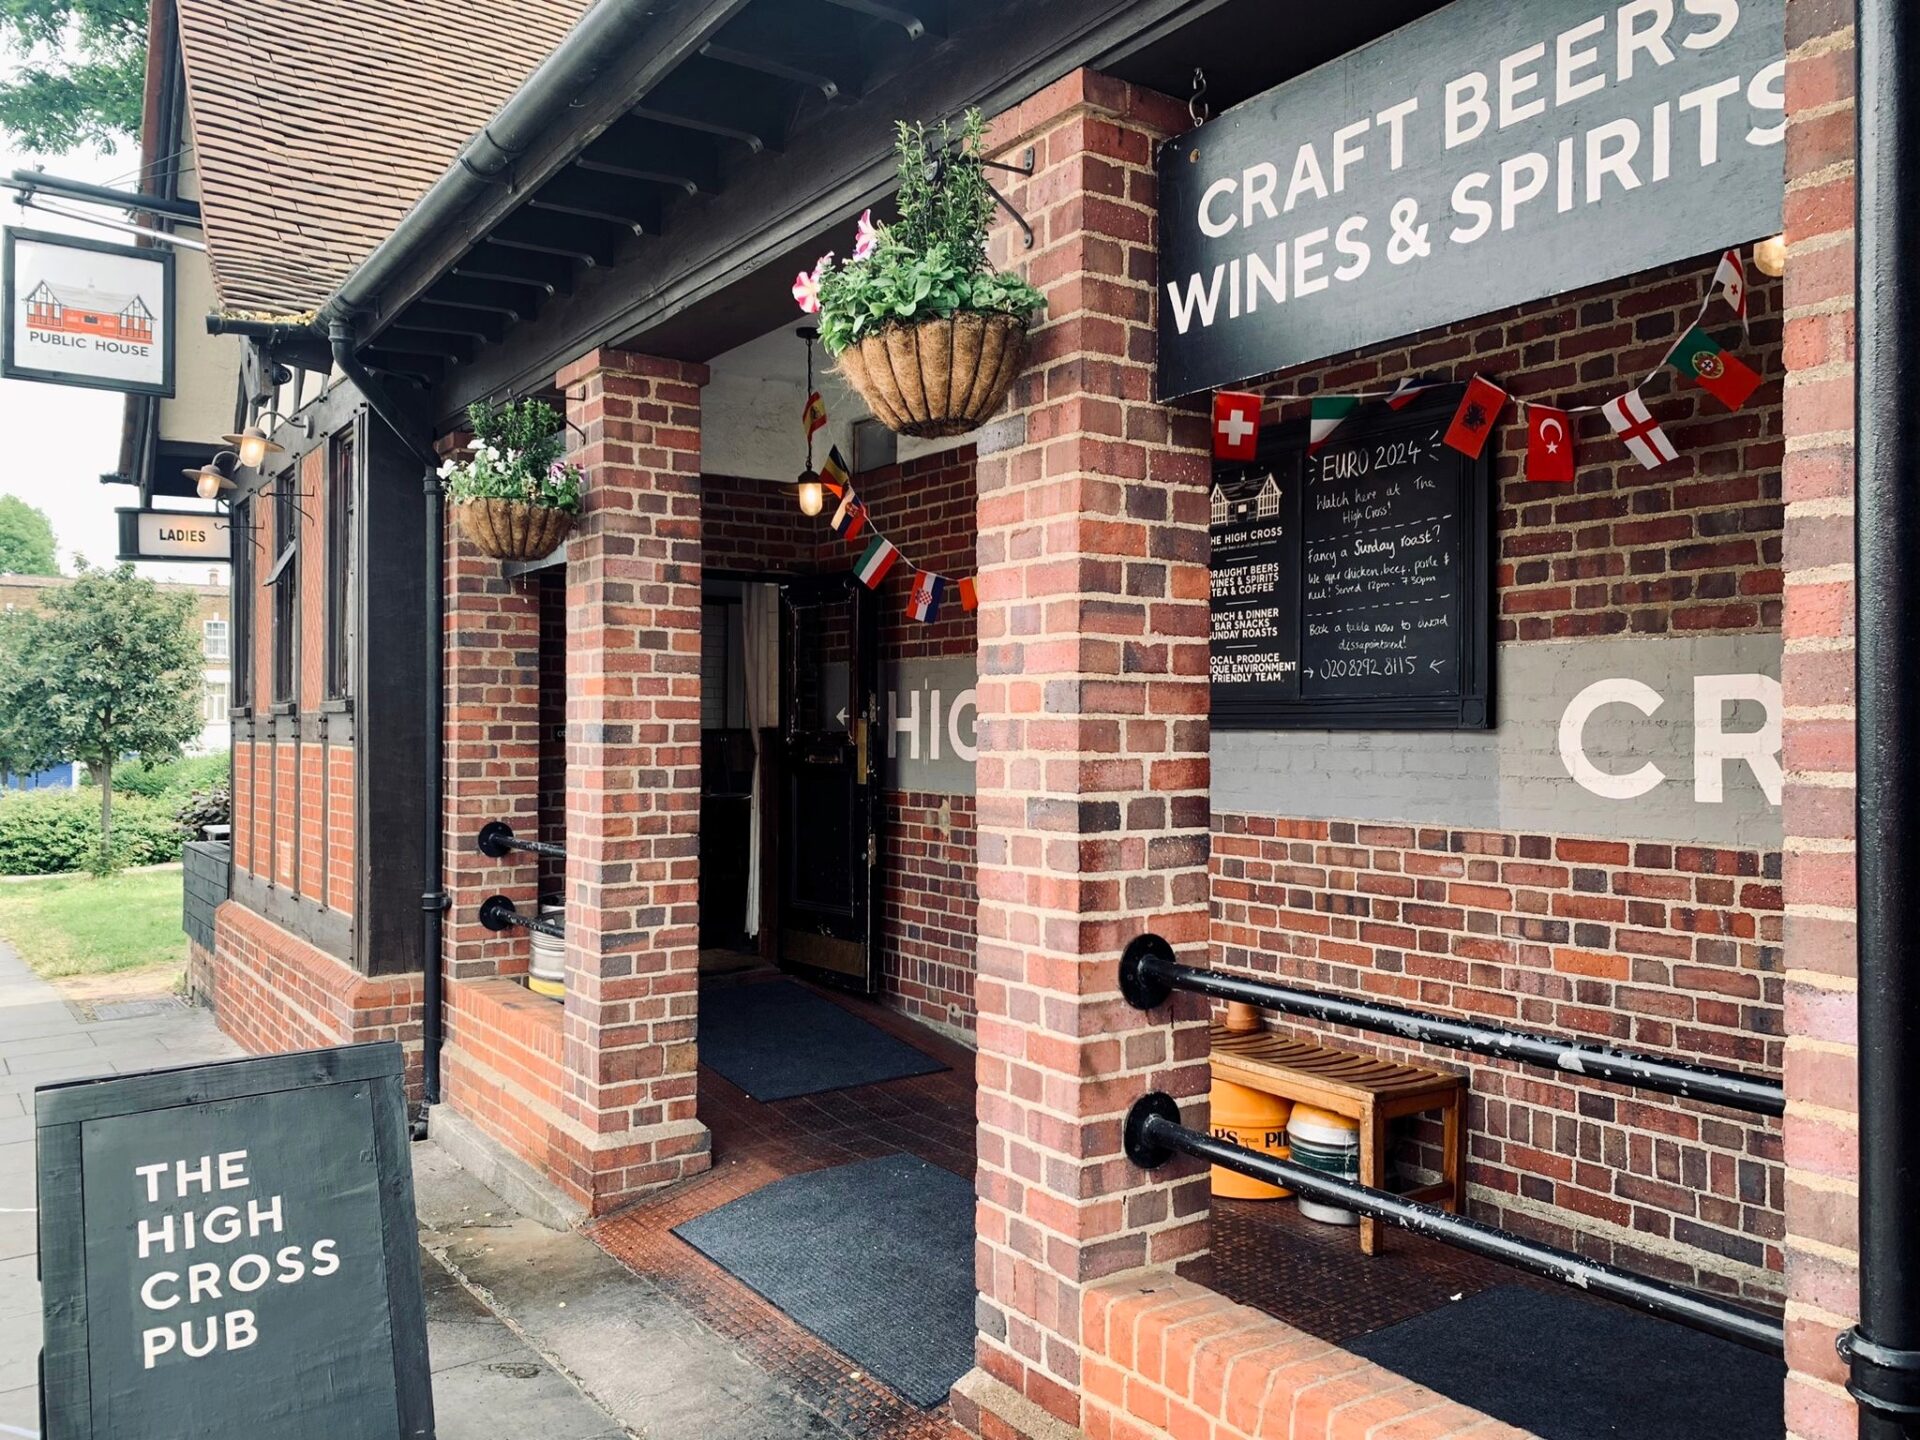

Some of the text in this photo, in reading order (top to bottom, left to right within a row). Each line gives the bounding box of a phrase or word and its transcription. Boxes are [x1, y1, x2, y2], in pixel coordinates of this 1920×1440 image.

[1197, 0, 1740, 238] CRAFT BEERS
[1167, 59, 1786, 335] WINES & SPIRITS
[29, 331, 149, 357] PUBLIC HOUSE
[1322, 440, 1422, 481] EURO 2024
[1316, 475, 1436, 510] Watch here at The
[1342, 501, 1392, 529] High Cross!
[159, 528, 206, 543] LADIES
[1224, 532, 1247, 544] HIGH
[1250, 526, 1283, 540] CROSS
[1307, 524, 1440, 568] Fancy a Sunday roast?
[1237, 576, 1243, 586] &
[1245, 572, 1279, 585] SPIRITS
[1250, 562, 1279, 574] BEERS
[1308, 573, 1320, 584] We
[1414, 555, 1439, 575] pork
[1212, 582, 1274, 597] TEA & COFFEE
[1335, 582, 1362, 596] Served
[1367, 582, 1390, 593] 12pm
[1215, 618, 1270, 631] BAR SNACKS
[1238, 610, 1243, 620] &
[1245, 607, 1279, 620] DINNER
[1242, 627, 1278, 638] ROASTS
[1309, 624, 1329, 636] Book
[1346, 621, 1370, 633] table
[1375, 623, 1394, 632] now
[1401, 620, 1411, 631] to
[1418, 614, 1448, 628] avoid
[1232, 661, 1296, 674] ENVIRONMENT
[1236, 652, 1280, 664] PRODUCE
[1212, 673, 1252, 683] FRIENDLY
[135, 1150, 250, 1202] THE
[137, 1195, 284, 1258] HIGH
[140, 1239, 341, 1311] CROSS
[142, 1309, 259, 1370] PUB
